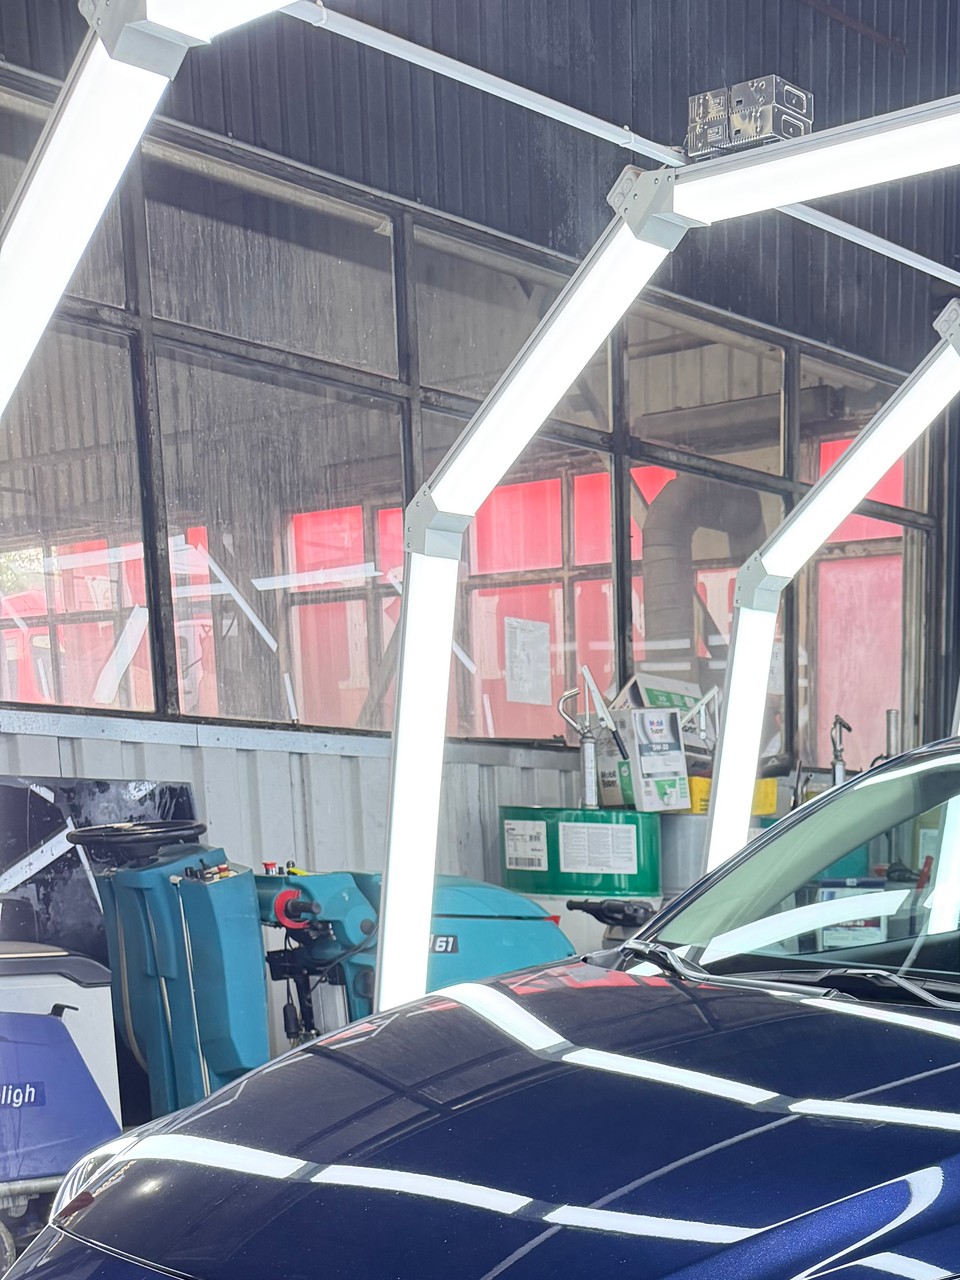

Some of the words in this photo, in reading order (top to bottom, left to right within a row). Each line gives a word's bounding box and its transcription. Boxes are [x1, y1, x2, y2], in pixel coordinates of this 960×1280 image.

[649, 719, 664, 727] Mobil
[435, 936, 454, 952] 61
[0, 1083, 36, 1108] ligh
